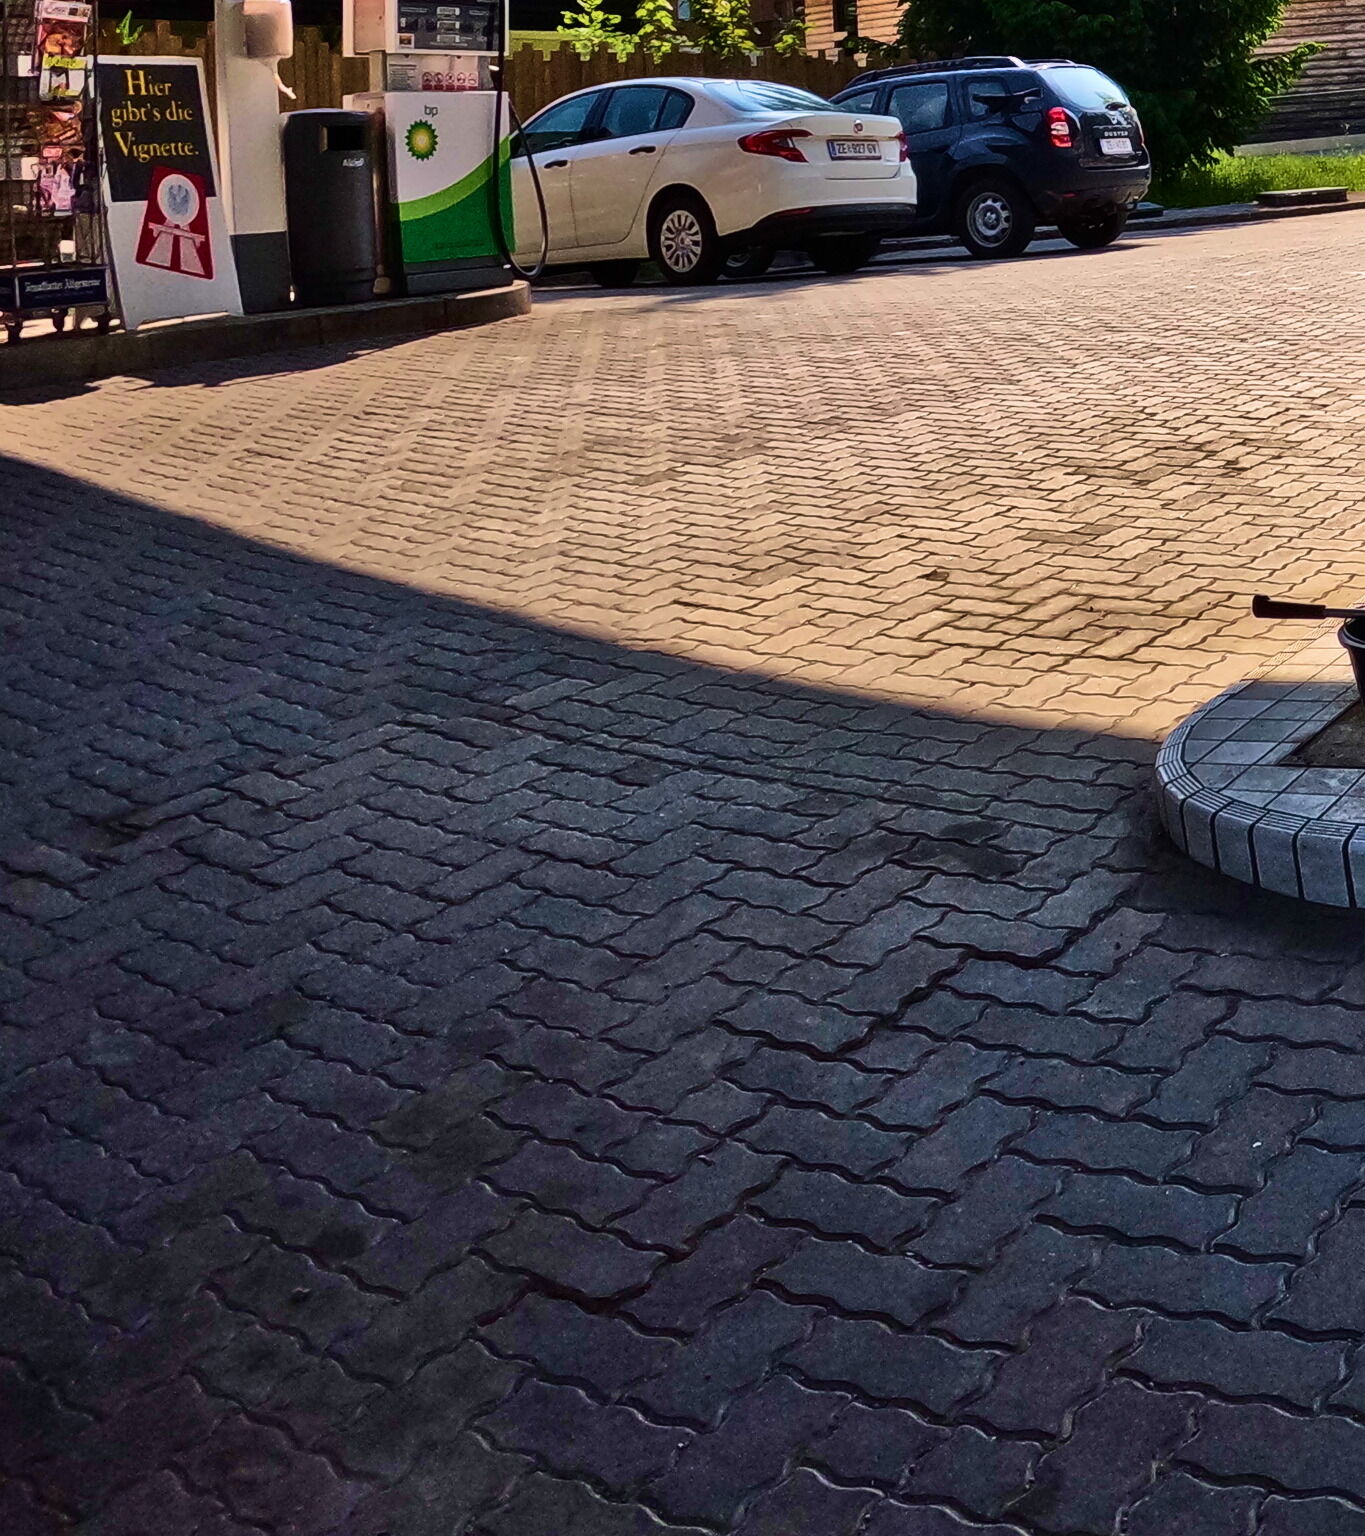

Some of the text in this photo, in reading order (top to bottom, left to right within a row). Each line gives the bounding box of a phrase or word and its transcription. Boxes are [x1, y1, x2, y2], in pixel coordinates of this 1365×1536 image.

[123, 69, 172, 96] Hier
[111, 100, 193, 128] gibt's die
[423, 104, 438, 117] bp
[113, 131, 200, 163] Vignette.
